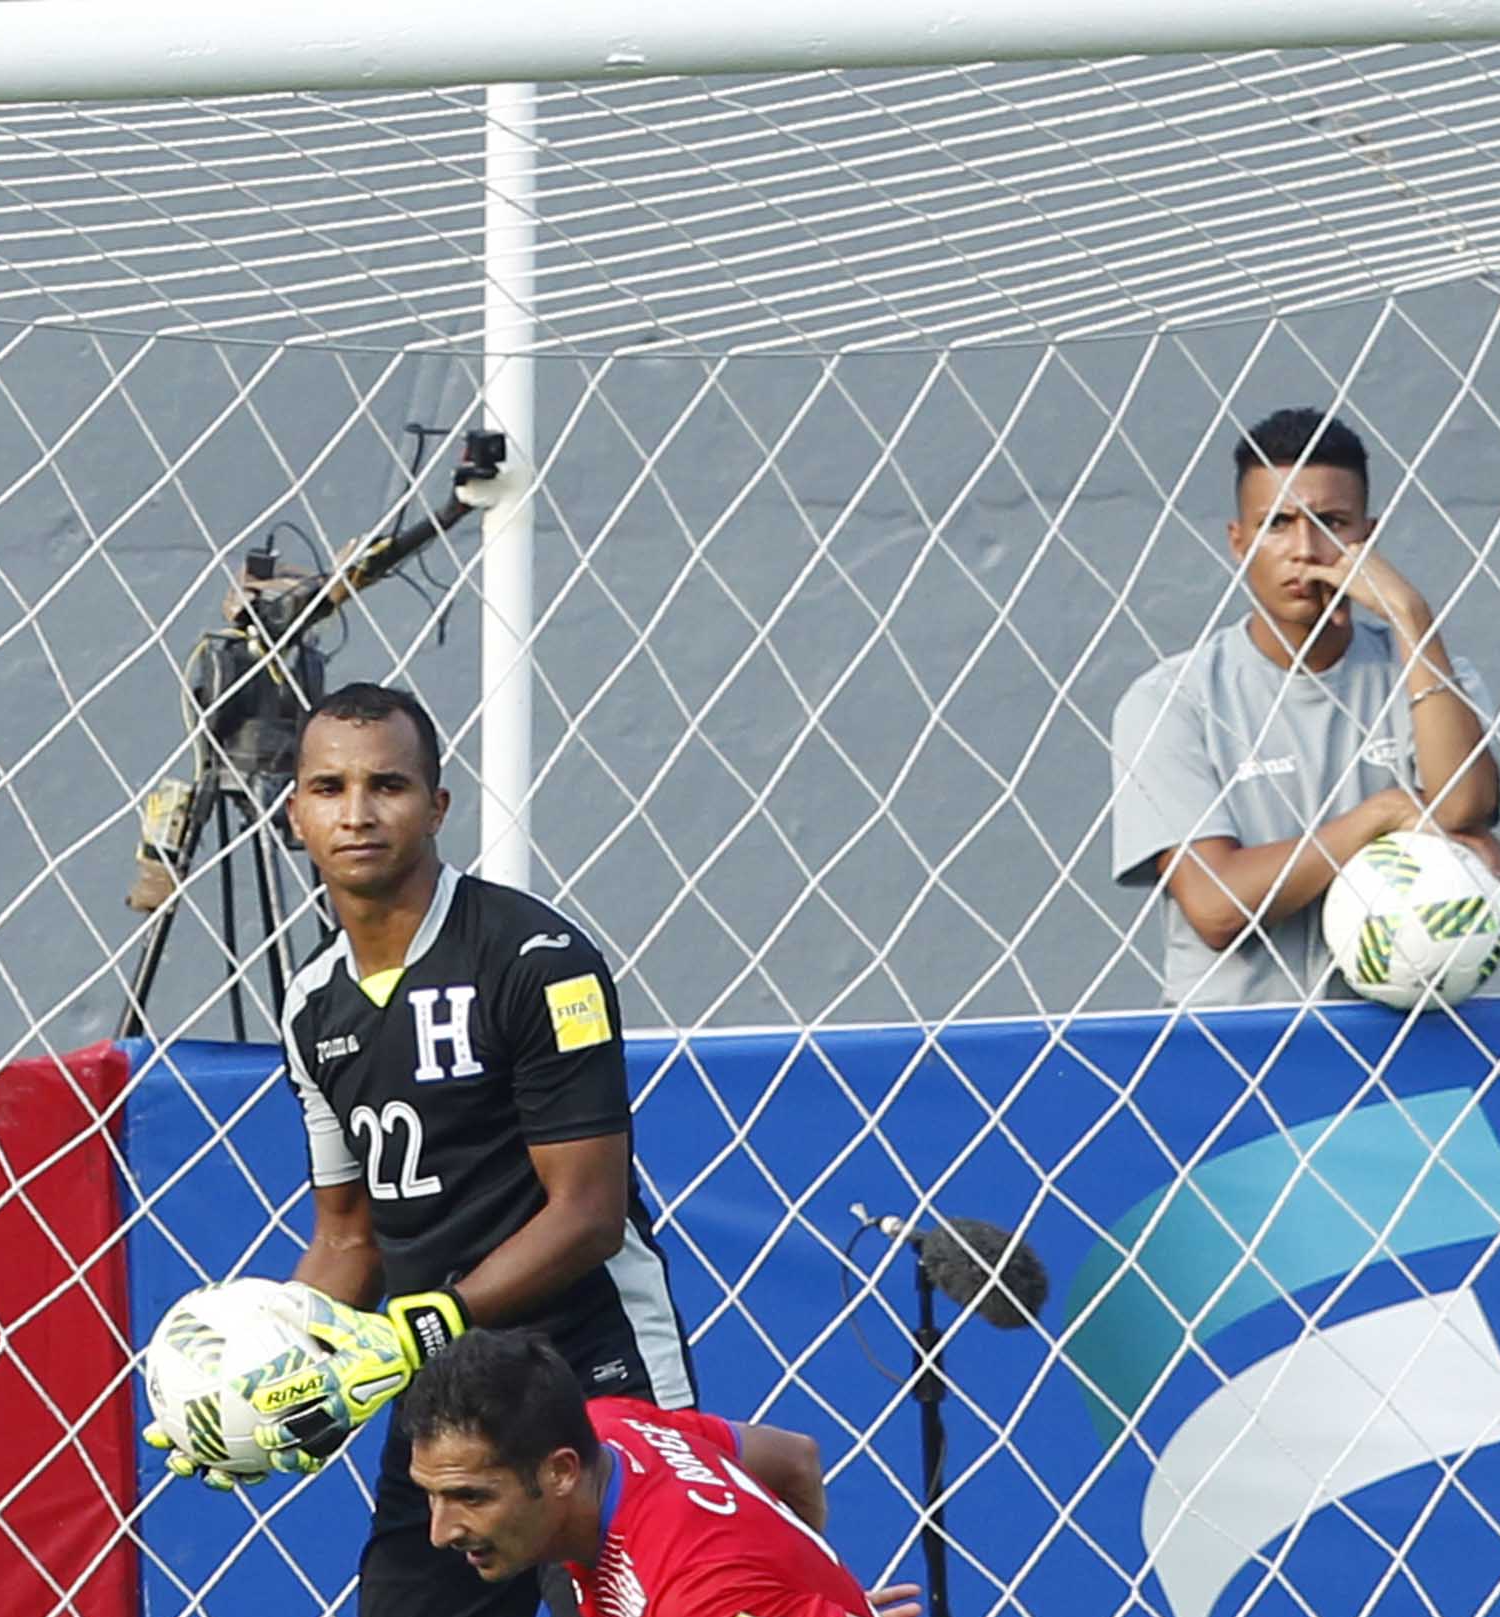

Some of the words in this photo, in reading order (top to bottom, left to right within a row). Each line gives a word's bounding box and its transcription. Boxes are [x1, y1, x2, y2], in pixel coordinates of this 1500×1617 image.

[408, 986, 484, 1081] H
[351, 1101, 443, 1200] 22
[268, 1374, 326, 1405] RINAT
